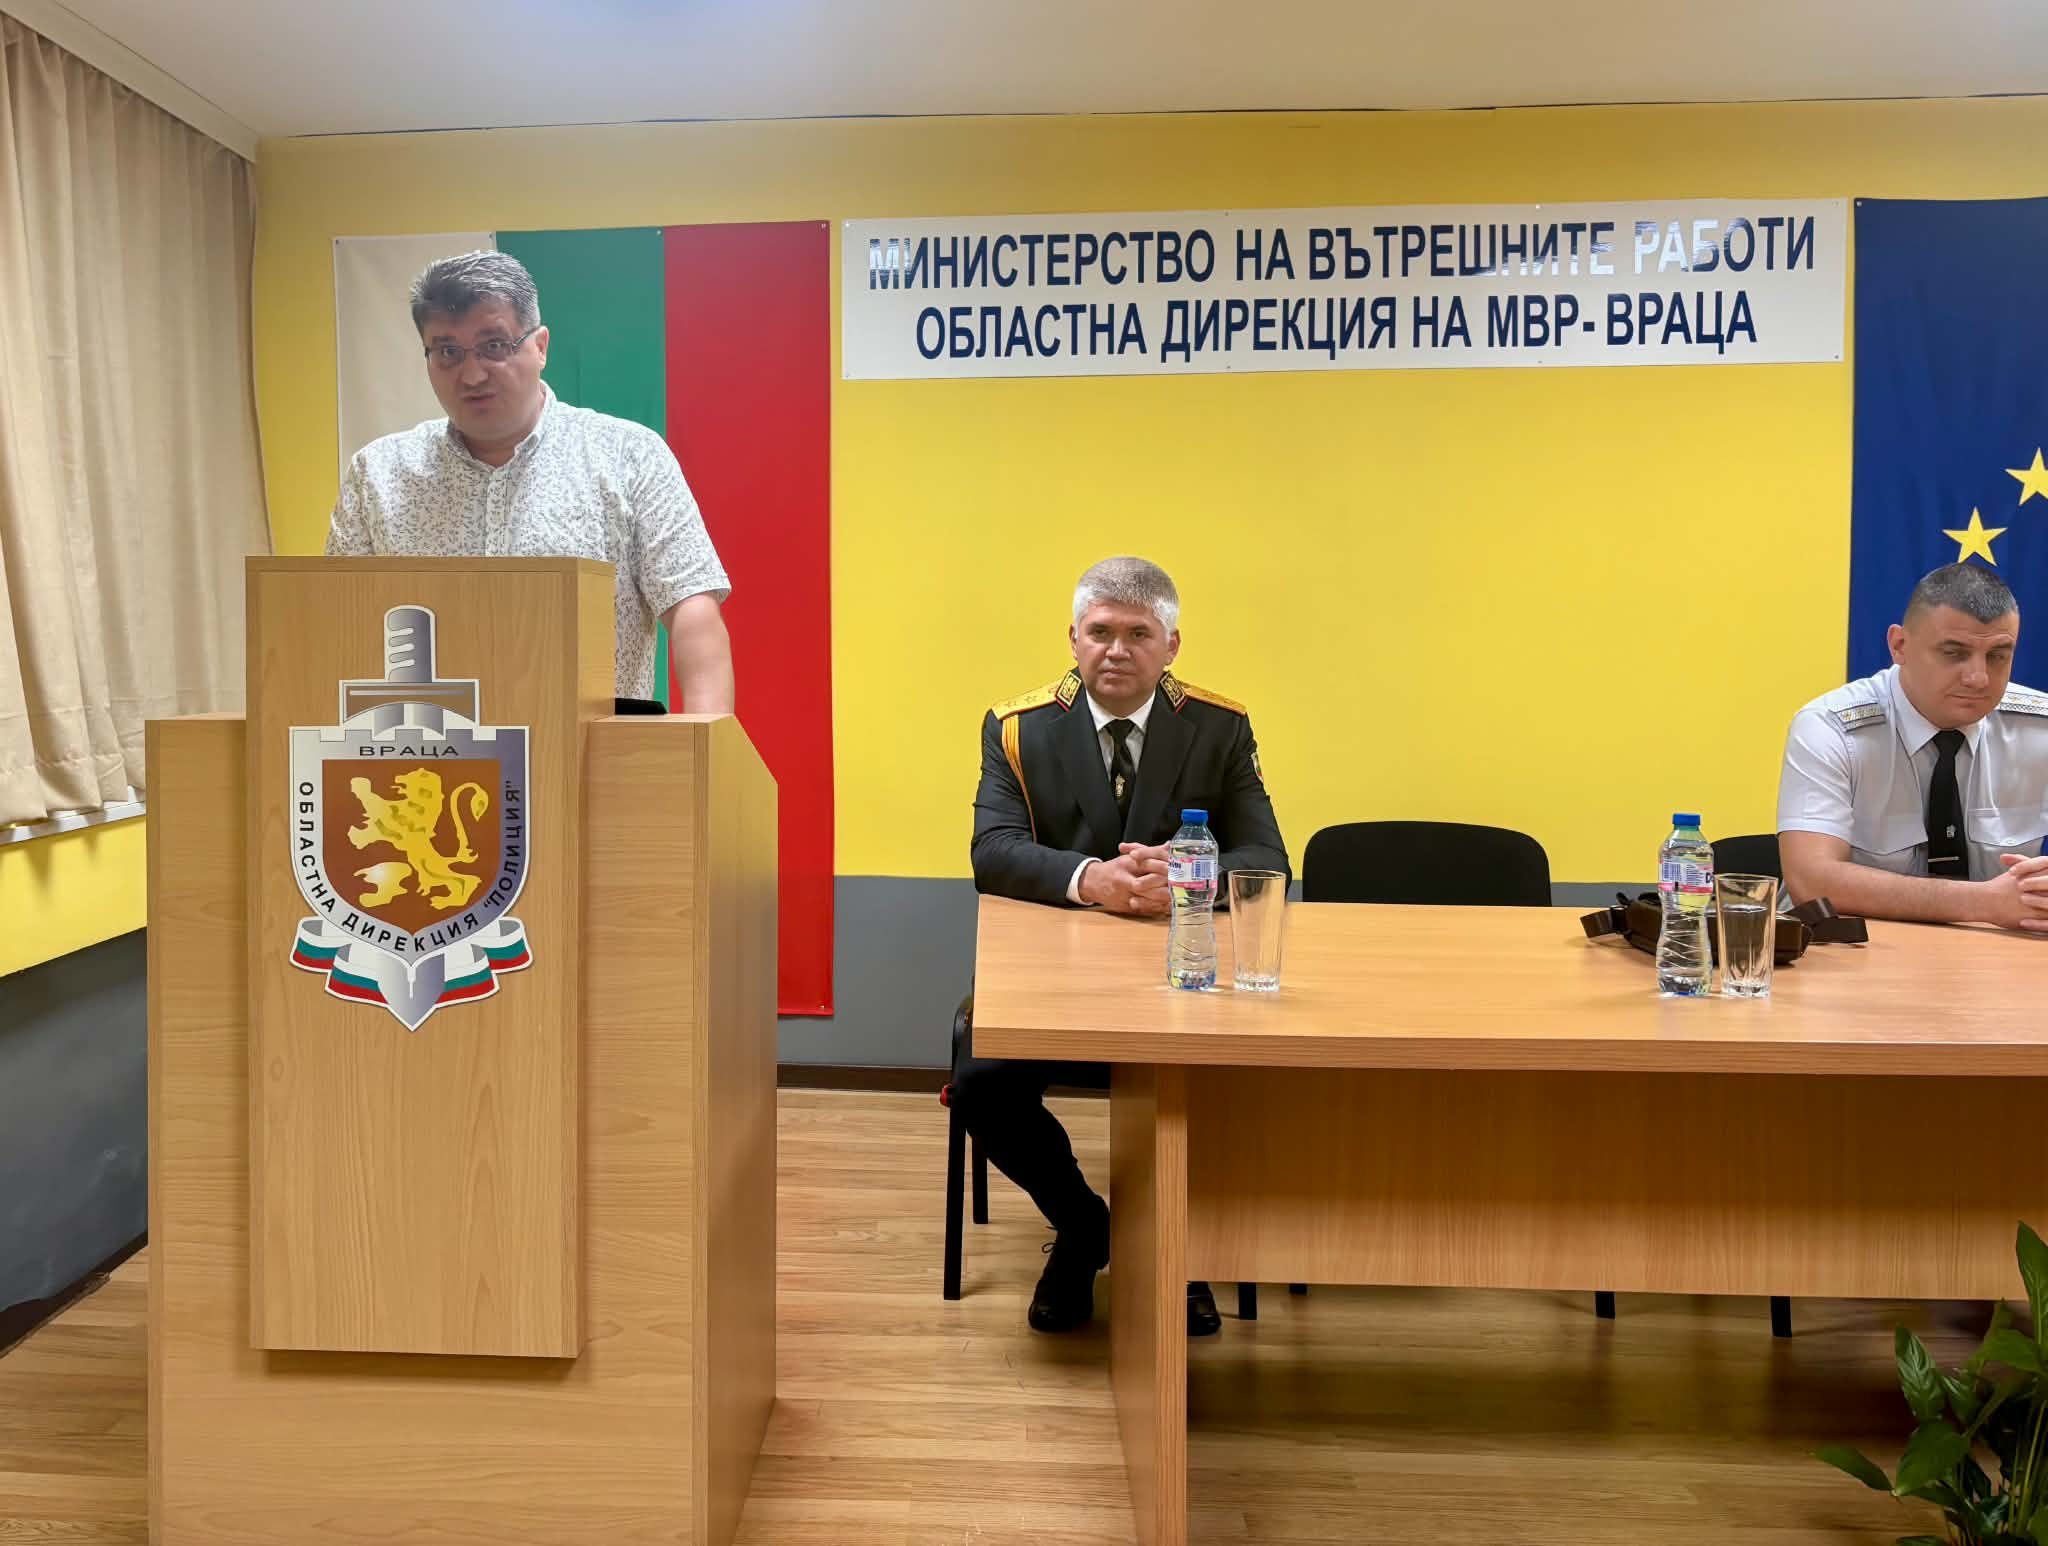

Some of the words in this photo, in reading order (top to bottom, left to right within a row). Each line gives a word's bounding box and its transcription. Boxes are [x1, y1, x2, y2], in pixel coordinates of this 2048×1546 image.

[869, 228, 1216, 290] МИНИСТЕРСТВО
[1236, 228, 1295, 282] НА
[1309, 221, 1615, 281] ВЪТРЕШНИТЕ
[1634, 216, 1816, 275] РАБОТИ
[916, 302, 1148, 360] ОБЛАСТНА
[1160, 296, 1397, 364] ДИРЕКЦИЯ
[1413, 295, 1473, 348] НА
[1606, 290, 1758, 355] ВРАЦА
[359, 746, 460, 758] ВРАЦА
[299, 781, 337, 913] ОБЛАСТНА
[341, 912, 479, 953] ДИРЕКЦИЯ
